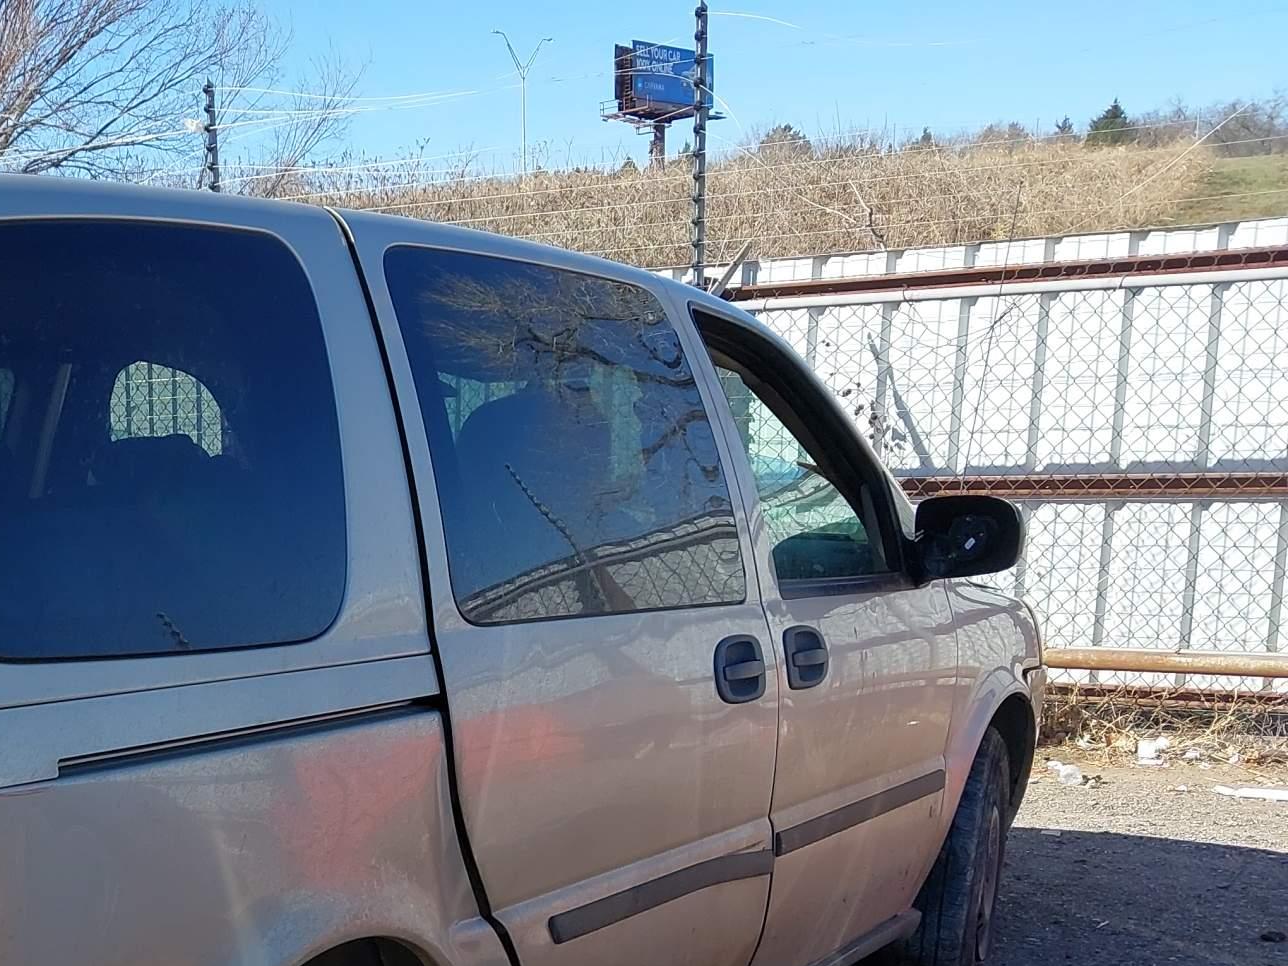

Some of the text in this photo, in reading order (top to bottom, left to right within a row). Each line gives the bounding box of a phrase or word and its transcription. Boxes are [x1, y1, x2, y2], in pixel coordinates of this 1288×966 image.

[636, 45, 680, 61] SELL YOUR CAR
[651, 61, 673, 74] ONLINE
